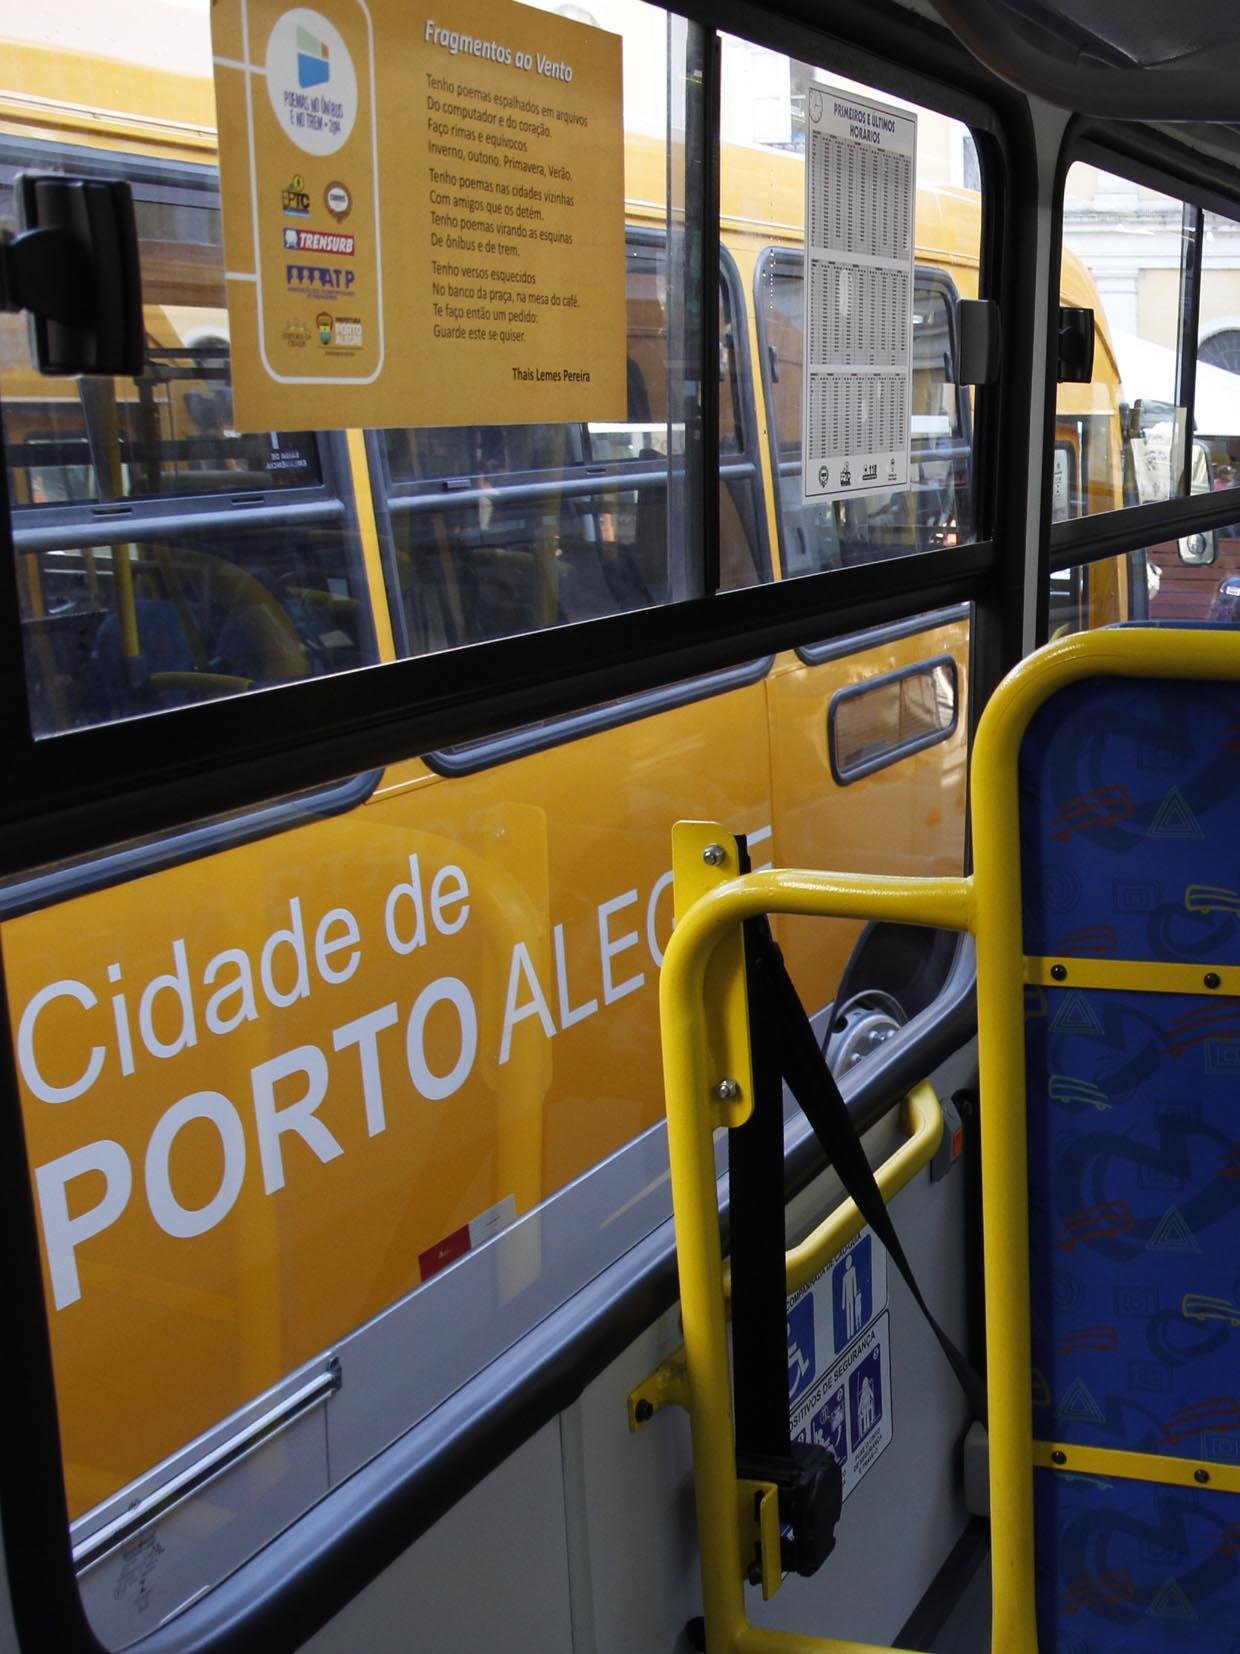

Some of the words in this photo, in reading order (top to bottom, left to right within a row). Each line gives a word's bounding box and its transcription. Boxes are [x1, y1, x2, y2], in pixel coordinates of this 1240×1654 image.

[425, 19, 511, 66] Fragmentos
[515, 50, 533, 70] ao
[536, 52, 573, 82] Vento
[426, 73, 455, 94] Tenho
[457, 82, 492, 103] poemas
[494, 95, 540, 116] espalhados
[541, 106, 554, 118] em
[556, 109, 588, 127] arquivos
[427, 96, 441, 112] Do
[442, 102, 496, 125] computador
[499, 117, 504, 127] e
[506, 115, 517, 130] do
[519, 120, 552, 139] coração.
[833, 102, 866, 124] PRIMEIROS
[867, 113, 871, 126] E
[428, 118, 449, 136] Faço
[451, 124, 476, 141] rimas
[478, 132, 483, 143] e
[428, 140, 466, 161] Inverno,
[503, 155, 547, 177] Primavera,
[429, 168, 457, 186] Tenho
[459, 176, 494, 193] poemas
[495, 182, 510, 196] nas
[512, 184, 542, 201] cidades
[543, 191, 574, 207] vizinhas
[429, 190, 451, 204] Com
[453, 195, 484, 213] amigos
[486, 202, 503, 215] que
[504, 205, 514, 216] os
[430, 211, 458, 228] Tenho
[460, 219, 494, 233] poemas
[496, 222, 527, 238] virando
[529, 228, 538, 238] as
[539, 230, 573, 246] esquinas
[299, 231, 354, 253] TRENSURB
[431, 233, 443, 247] De
[446, 234, 476, 251] ônibus
[478, 241, 483, 251] e
[484, 240, 496, 253] de
[498, 244, 520, 257] trem.
[320, 268, 355, 289] ATP
[431, 261, 460, 277] Tenho
[461, 267, 489, 279] versos
[490, 269, 536, 285] esquecidos
[432, 283, 446, 297] No
[448, 284, 475, 299] banco
[476, 286, 487, 300] da
[489, 289, 514, 304] praça,
[516, 292, 527, 302] na
[528, 294, 549, 305] mesa
[550, 294, 561, 307] do
[433, 303, 443, 317] Te
[445, 305, 464, 321] faço
[466, 306, 490, 320] então
[493, 311, 507, 321] um
[433, 324, 466, 340] Guarde
[468, 328, 486, 340] este
[488, 330, 498, 341] se
[499, 329, 526, 344] quiser.
[536, 369, 561, 382] Lemes
[563, 370, 591, 383] Pereira
[17, 897, 362, 1104] Cidade
[385, 853, 471, 956] de
[34, 976, 479, 1312] PORTO
[822, 1380, 833, 1394] DE
[834, 1330, 876, 1382] SEGURANÇA
